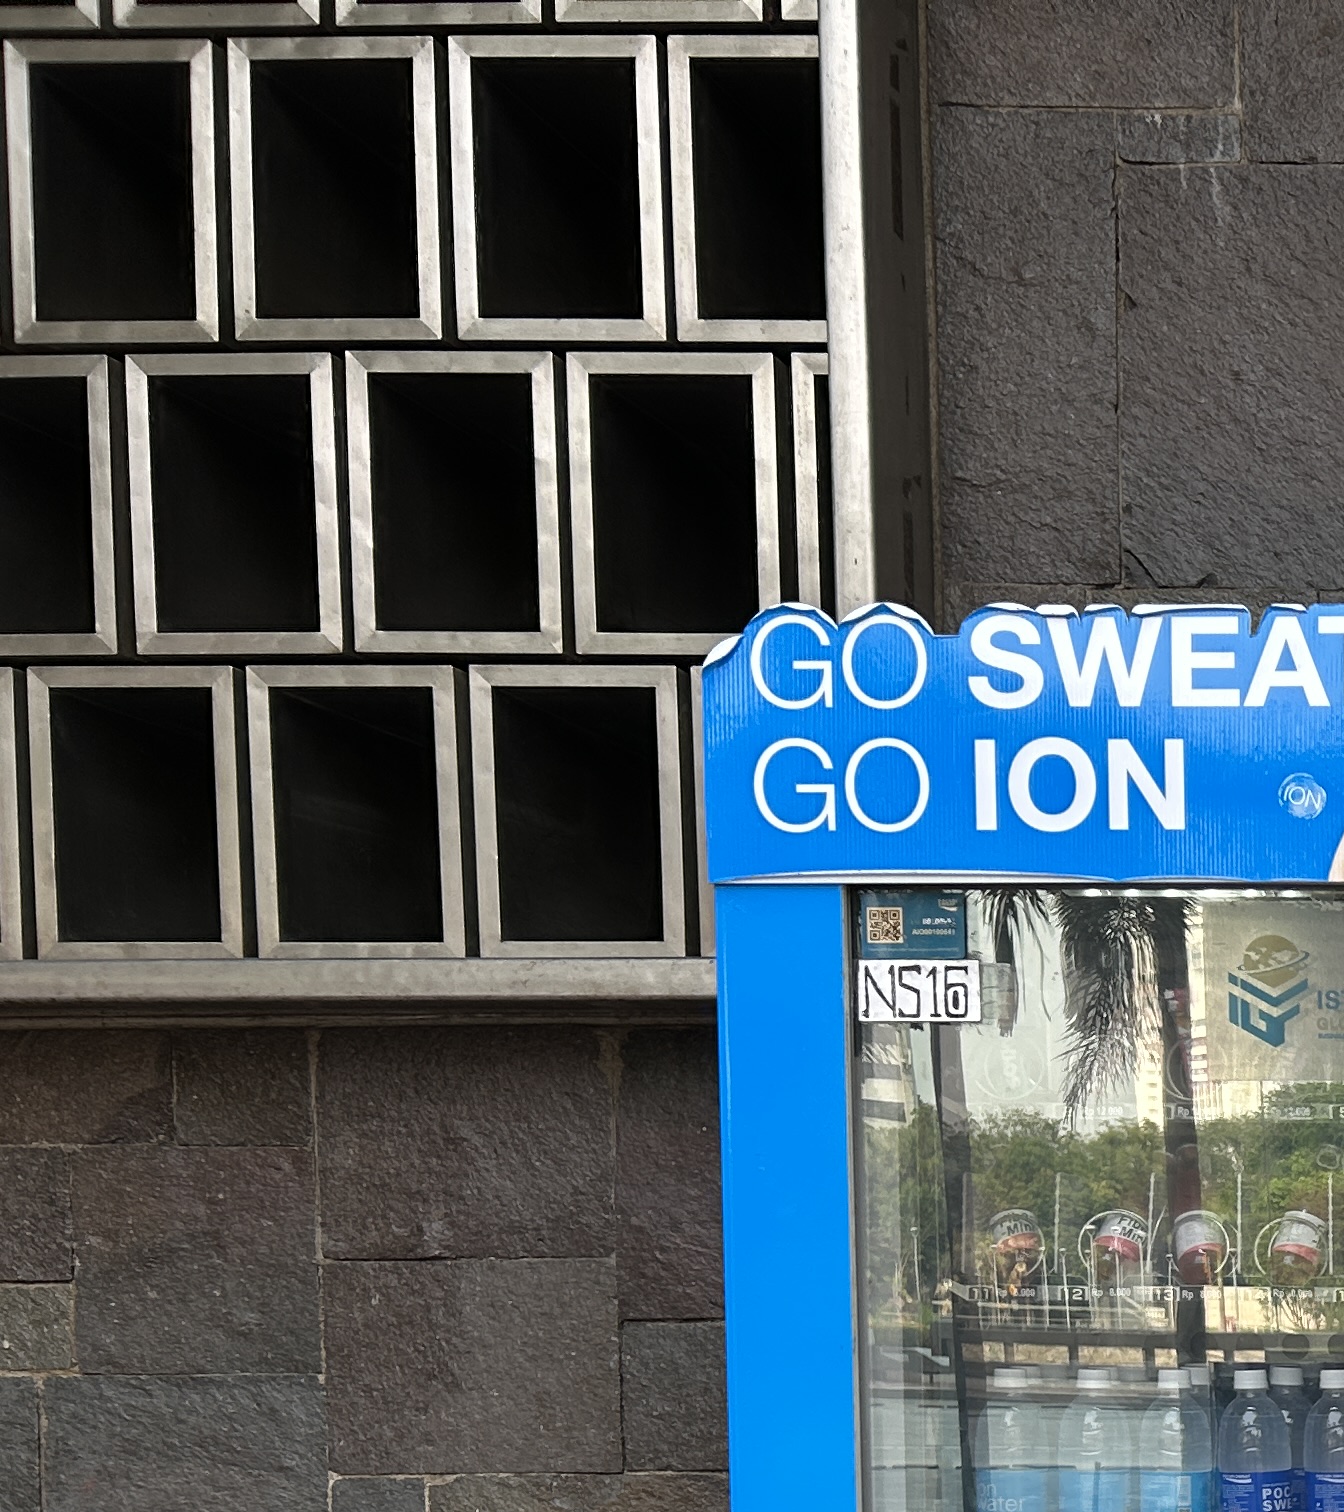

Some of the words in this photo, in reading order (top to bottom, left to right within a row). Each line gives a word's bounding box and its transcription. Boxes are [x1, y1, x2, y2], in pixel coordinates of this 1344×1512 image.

[751, 615, 926, 711] GO
[752, 736, 931, 834] GO
[974, 736, 1187, 833] ION
[1283, 784, 1322, 808] ION
[861, 964, 969, 1019] NS16
